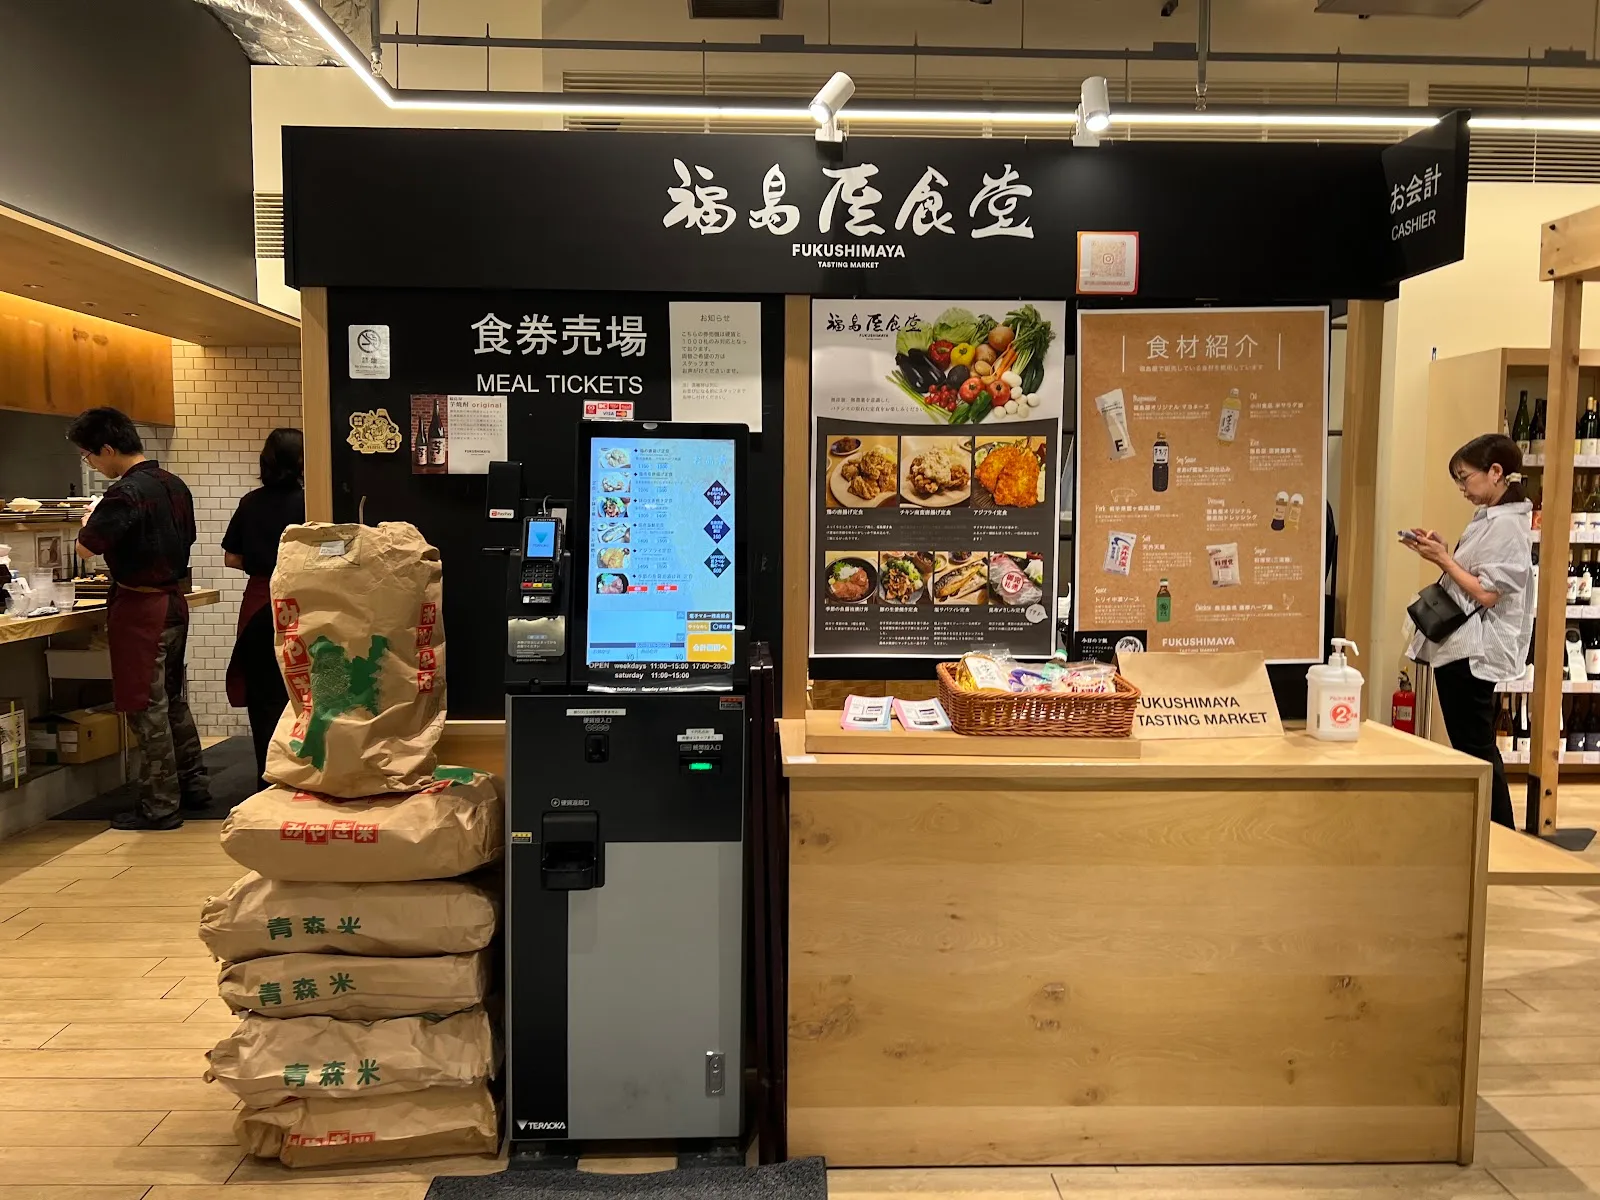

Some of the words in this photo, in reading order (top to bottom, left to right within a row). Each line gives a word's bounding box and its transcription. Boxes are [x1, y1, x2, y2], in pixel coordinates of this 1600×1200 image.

[662, 157, 1035, 239] 福島屋食堂
[1390, 163, 1442, 214] お会計
[1391, 209, 1437, 241] CASHIER
[792, 243, 905, 259] FUKUSHIMAYA
[817, 261, 848, 269] TASTING
[700, 314, 730, 322] お知らせ
[826, 312, 921, 333] 福島屋食堂
[471, 313, 647, 357] 食券売場
[1146, 334, 1259, 360] 食材紹介
[476, 374, 540, 393] MEAL
[545, 374, 643, 394] TICKETS
[1162, 637, 1235, 647] FUKUSHIMAYA
[614, 672, 644, 680] saturday
[1136, 714, 1201, 727] TASTING
[1204, 712, 1268, 725] MARKET
[1335, 706, 1347, 722] 2
[283, 820, 379, 844] みやぎ米
[267, 916, 361, 940] 青森米
[258, 972, 357, 1007] 青森米
[283, 1058, 381, 1087] 青森米
[527, 1121, 566, 1130] TERAOKA
